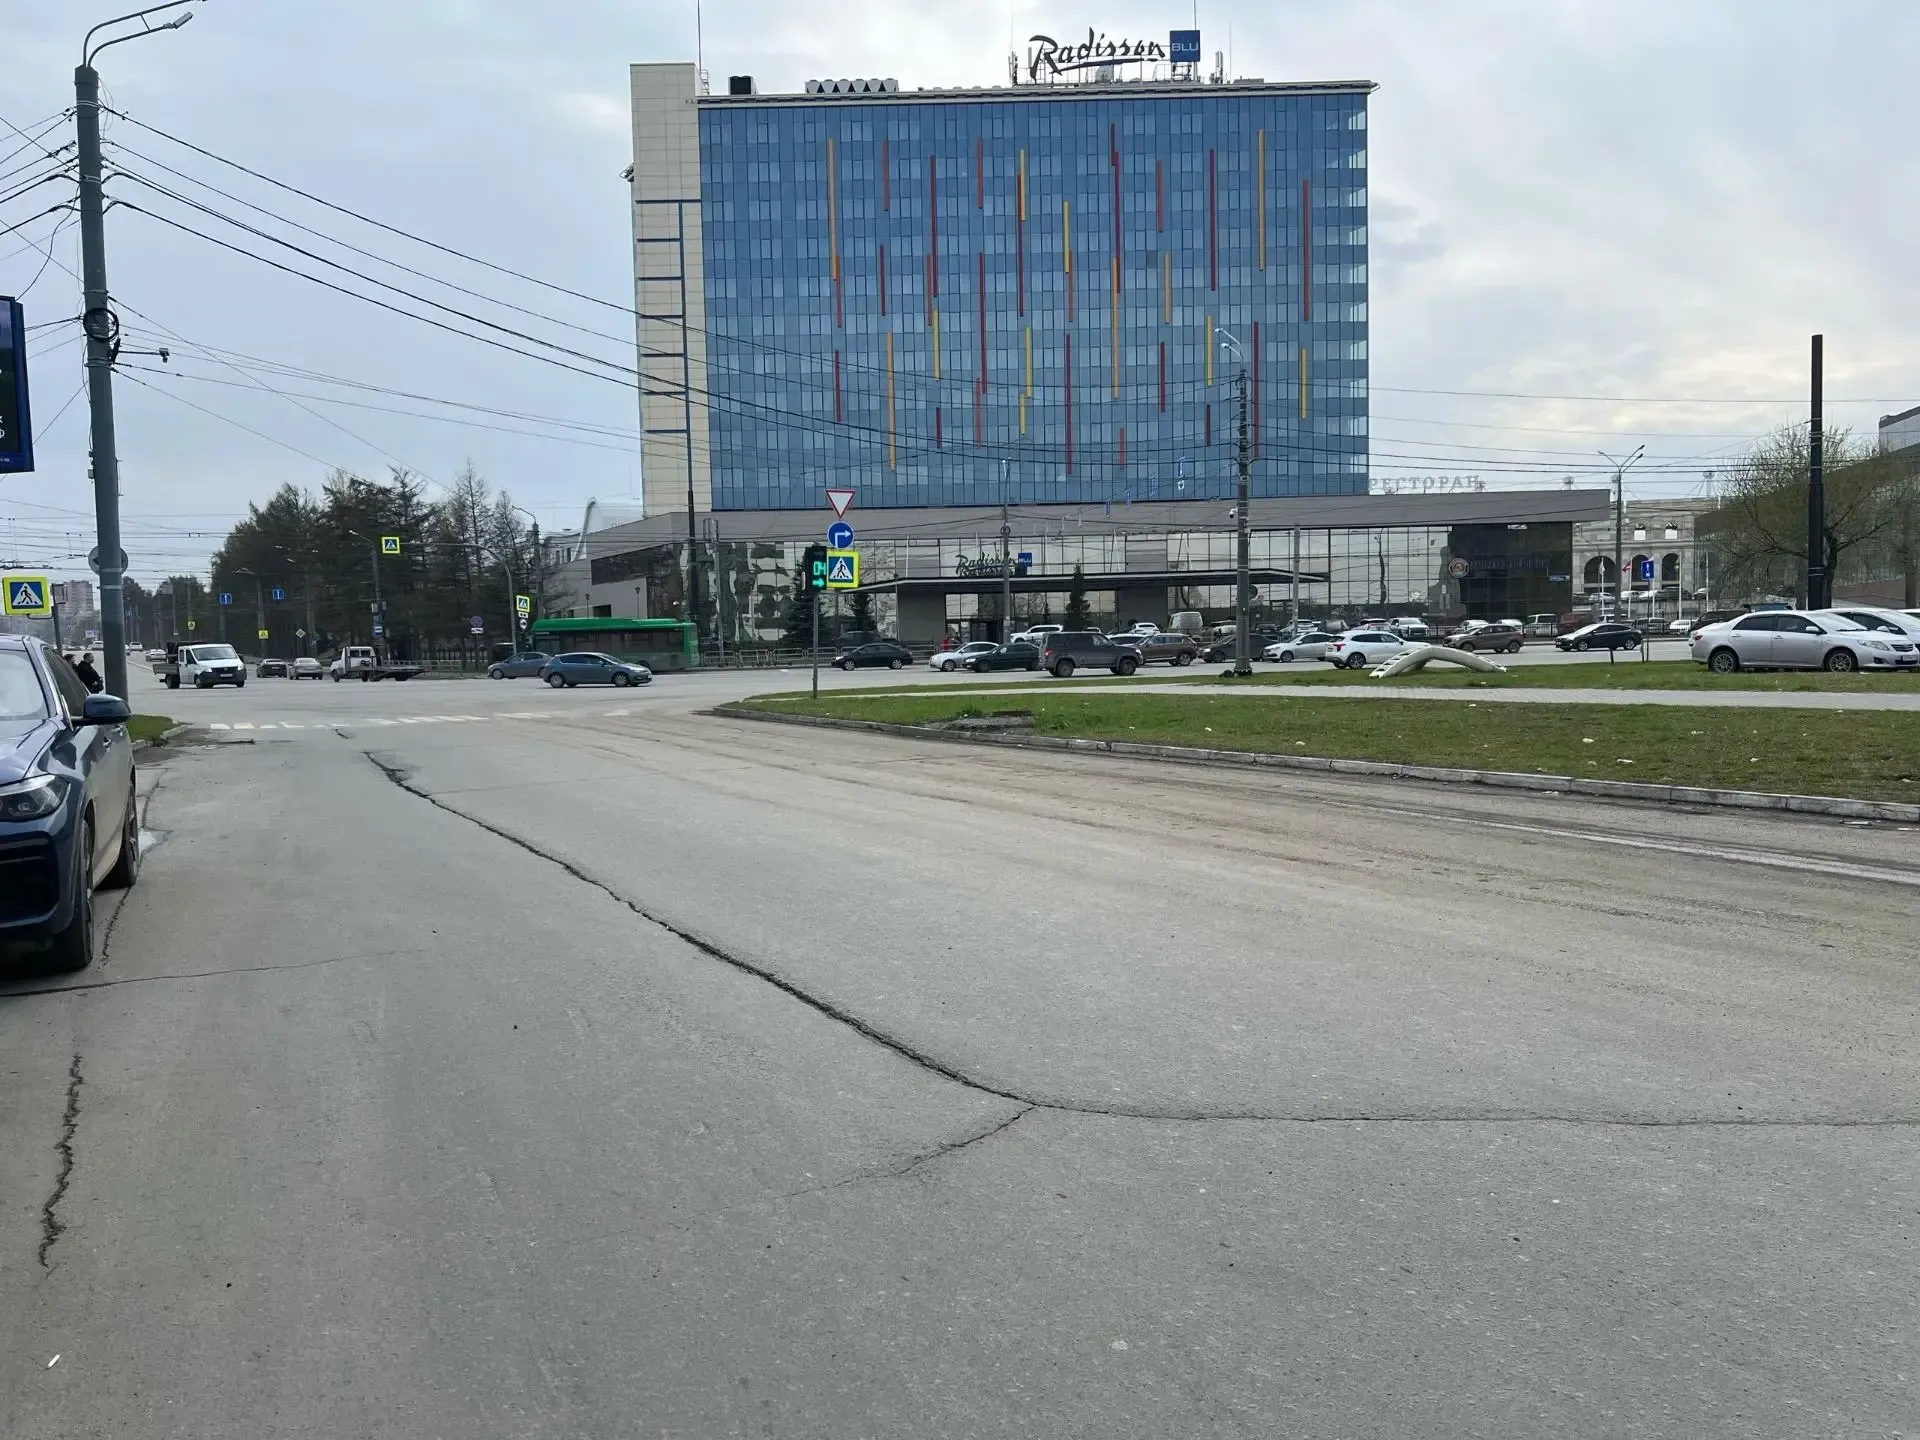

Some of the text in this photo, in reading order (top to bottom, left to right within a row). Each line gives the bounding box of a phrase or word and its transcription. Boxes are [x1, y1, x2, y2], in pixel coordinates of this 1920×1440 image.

[1029, 26, 1199, 79] Radisson BLU
[1369, 475, 1479, 490] РЕСТОРАН
[955, 551, 1016, 575] Radissn
